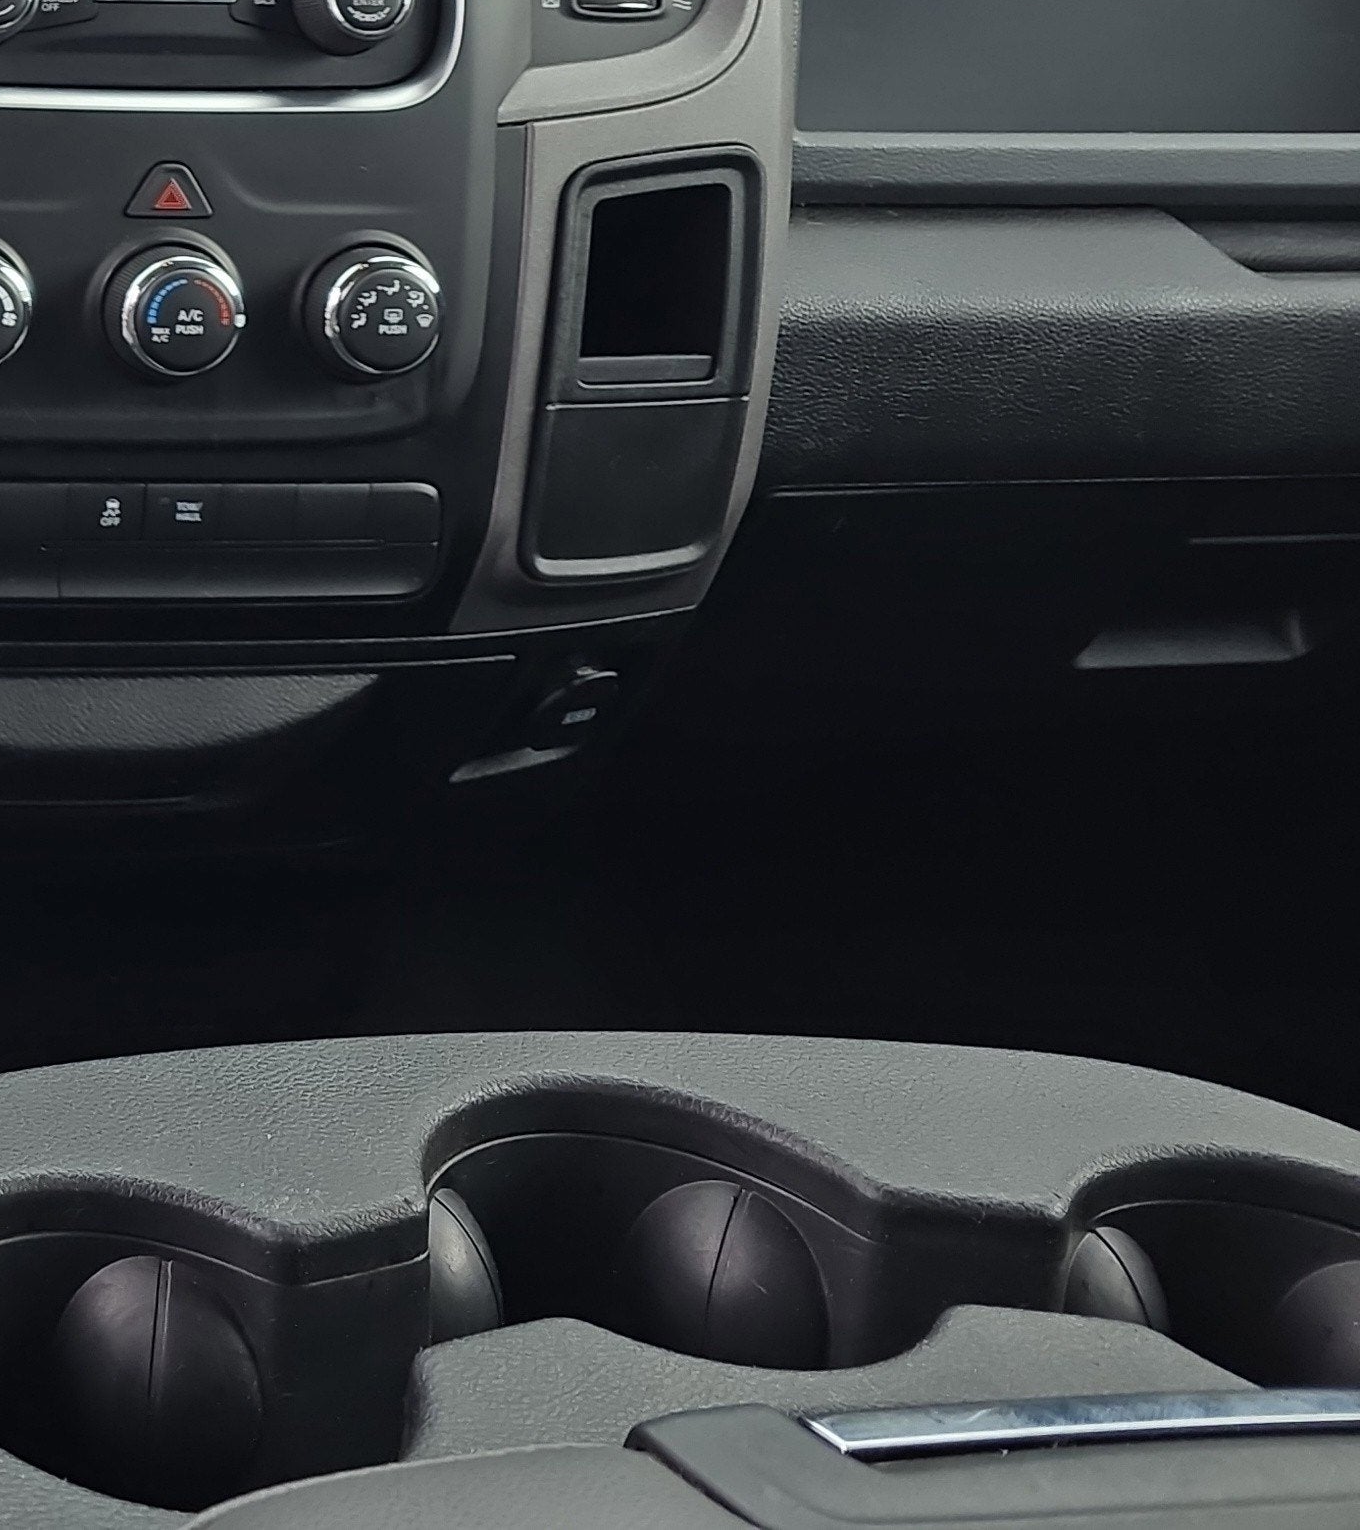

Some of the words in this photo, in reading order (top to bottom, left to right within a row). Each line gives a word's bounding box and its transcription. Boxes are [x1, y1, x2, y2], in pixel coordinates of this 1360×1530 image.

[41, 3, 60, 12] OFF
[177, 308, 204, 322] A/C
[175, 324, 204, 335] PUSH
[378, 324, 408, 335] PUSH
